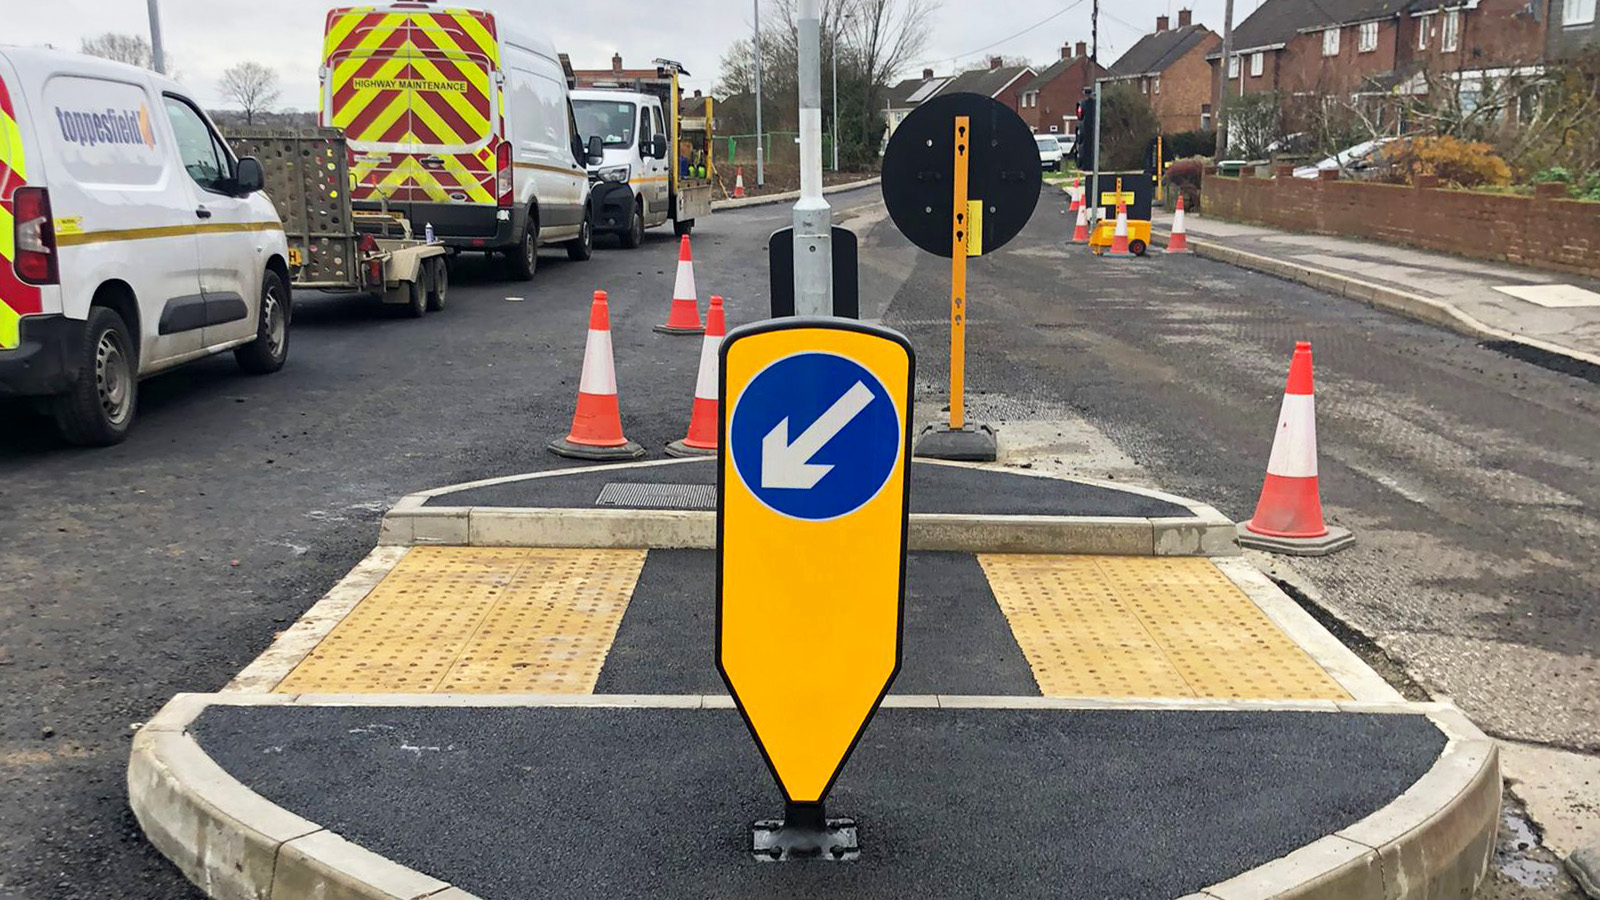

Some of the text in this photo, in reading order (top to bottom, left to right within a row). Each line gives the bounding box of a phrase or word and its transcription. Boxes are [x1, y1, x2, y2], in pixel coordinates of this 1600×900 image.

[354, 79, 466, 91] HIGHWAY MAINTENANCE
[55, 106, 143, 147] toppesfield
